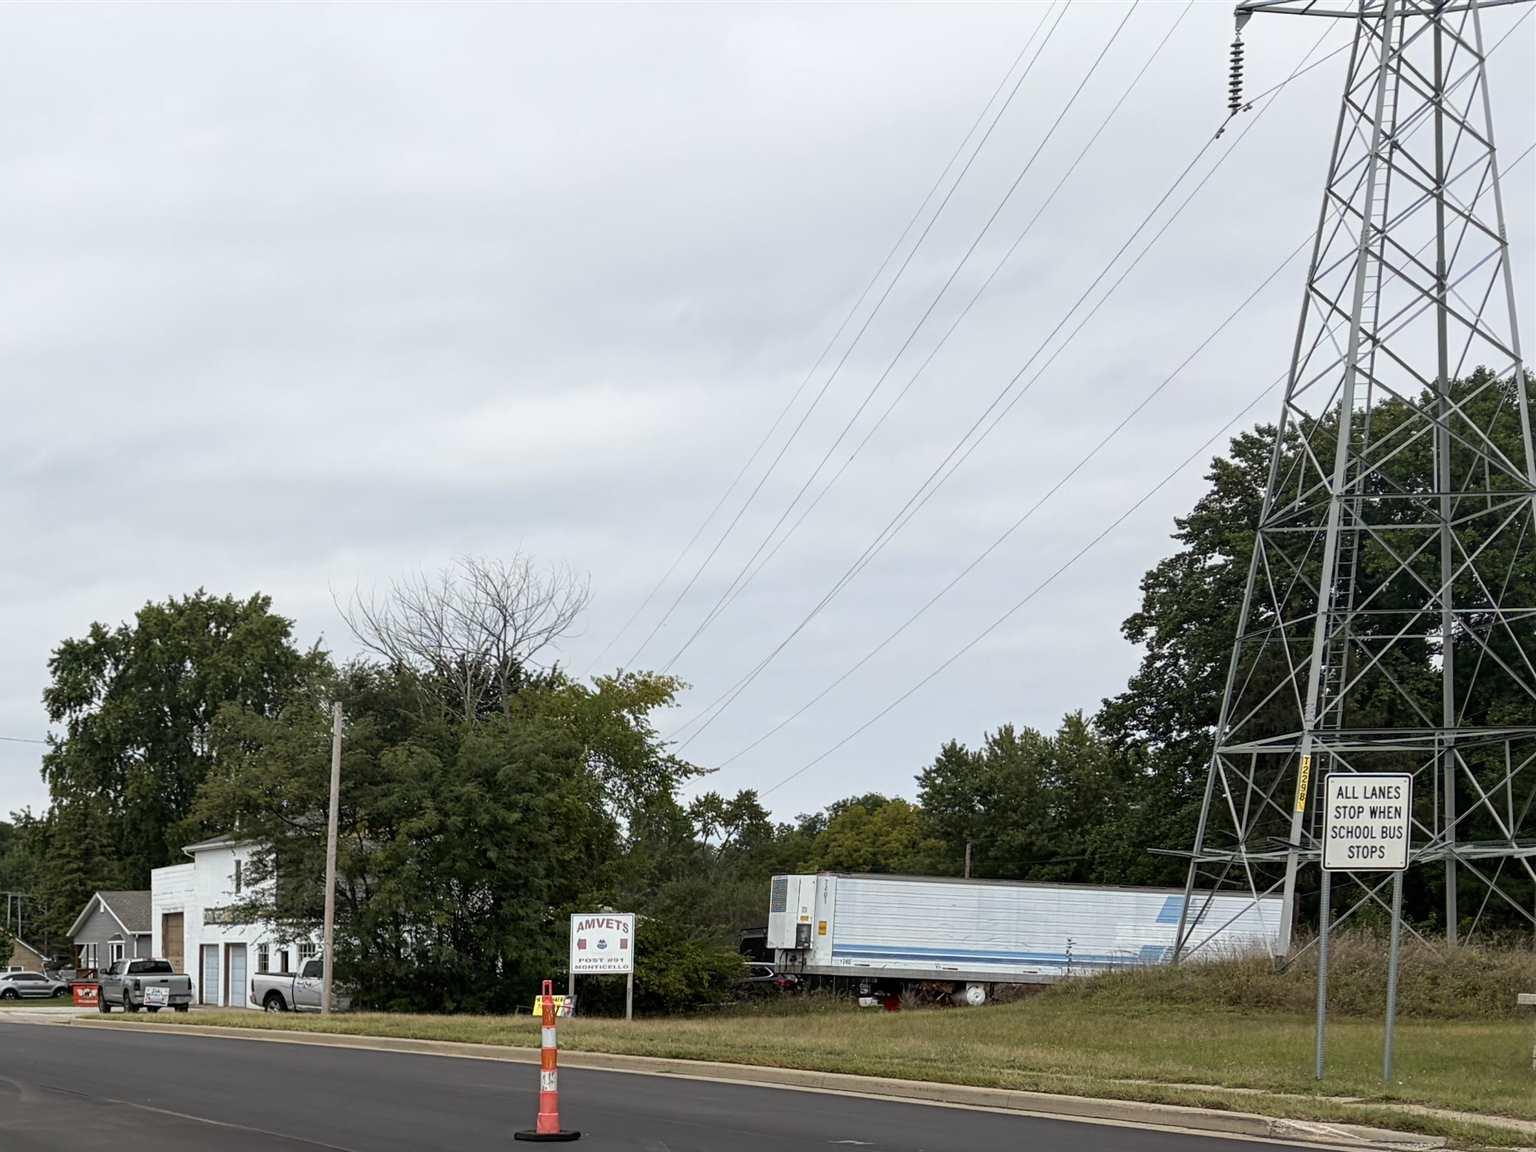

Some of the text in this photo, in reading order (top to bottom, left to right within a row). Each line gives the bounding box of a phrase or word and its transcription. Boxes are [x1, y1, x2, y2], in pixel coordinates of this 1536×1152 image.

[1299, 757, 1310, 801] T2298
[1336, 786, 1401, 800] ALL LANES
[1334, 805, 1402, 820] STOP WHEN
[1330, 826, 1403, 839] SCHOOL BUS
[1348, 845, 1386, 860] STOPS
[577, 918, 629, 934] AMVETS
